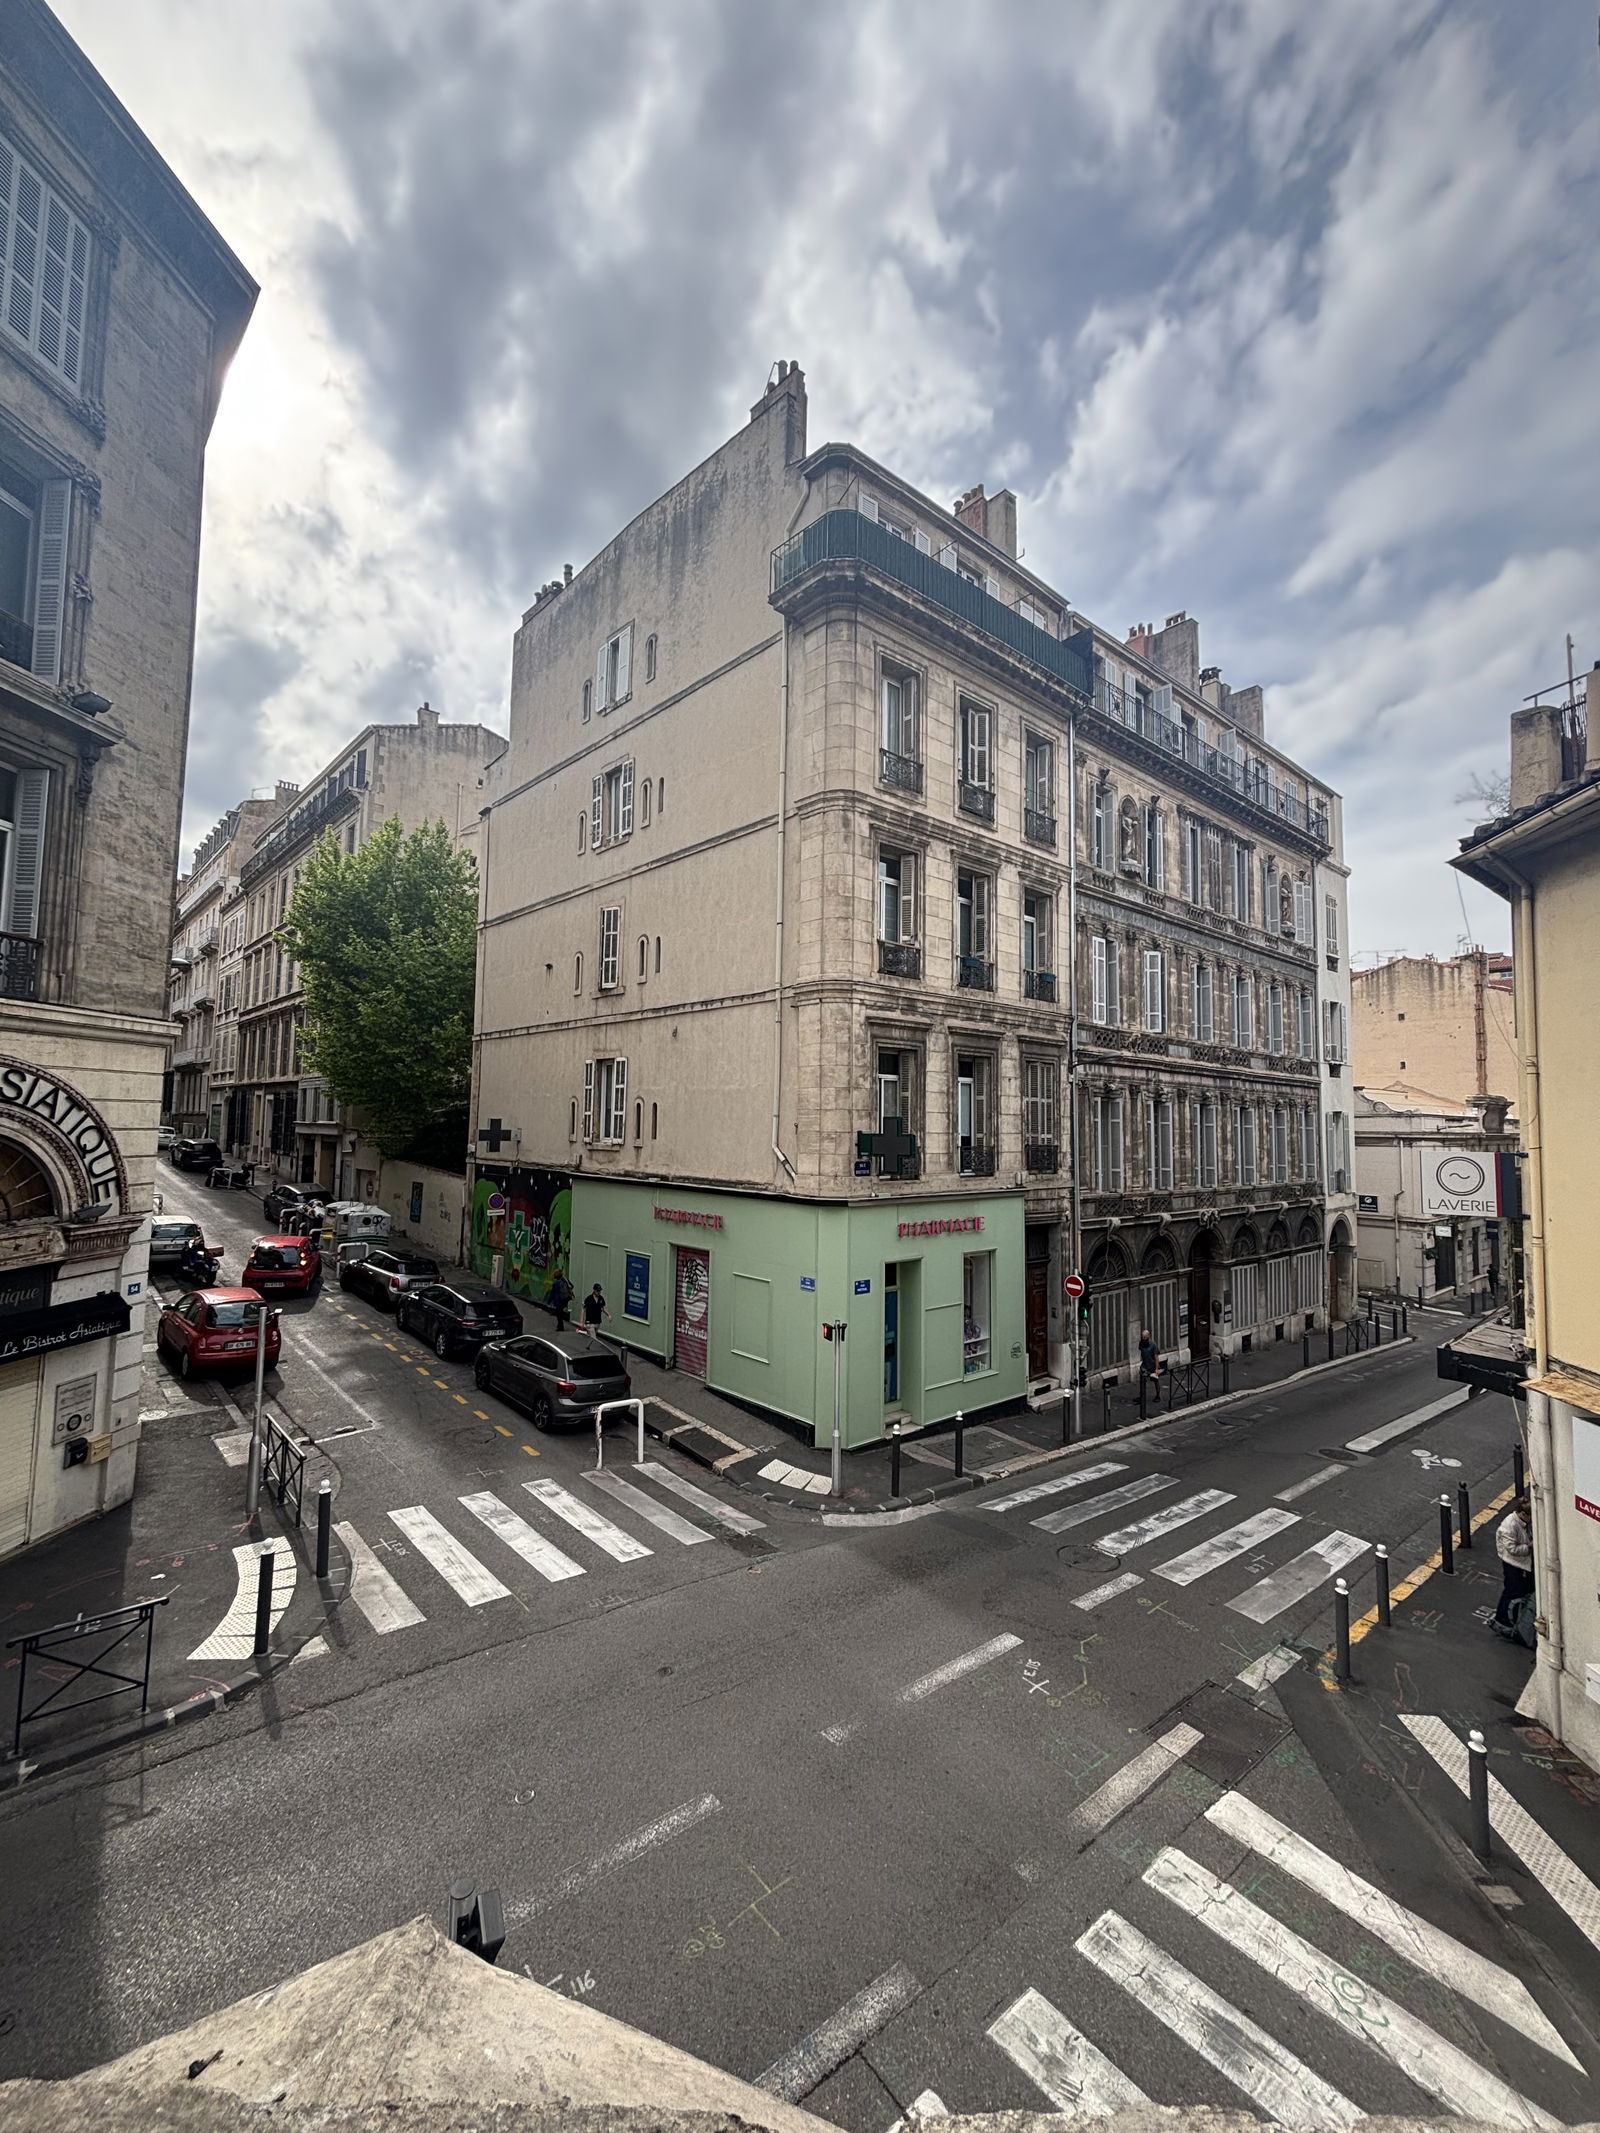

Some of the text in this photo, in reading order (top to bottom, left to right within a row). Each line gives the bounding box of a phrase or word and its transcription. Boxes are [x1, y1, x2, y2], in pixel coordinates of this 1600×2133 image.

[1428, 1198, 1496, 1213] LAVERIE
[898, 1216, 985, 1238] PHARMACIE
[0, 1320, 121, 1358] Le Bistrot Asiatique
